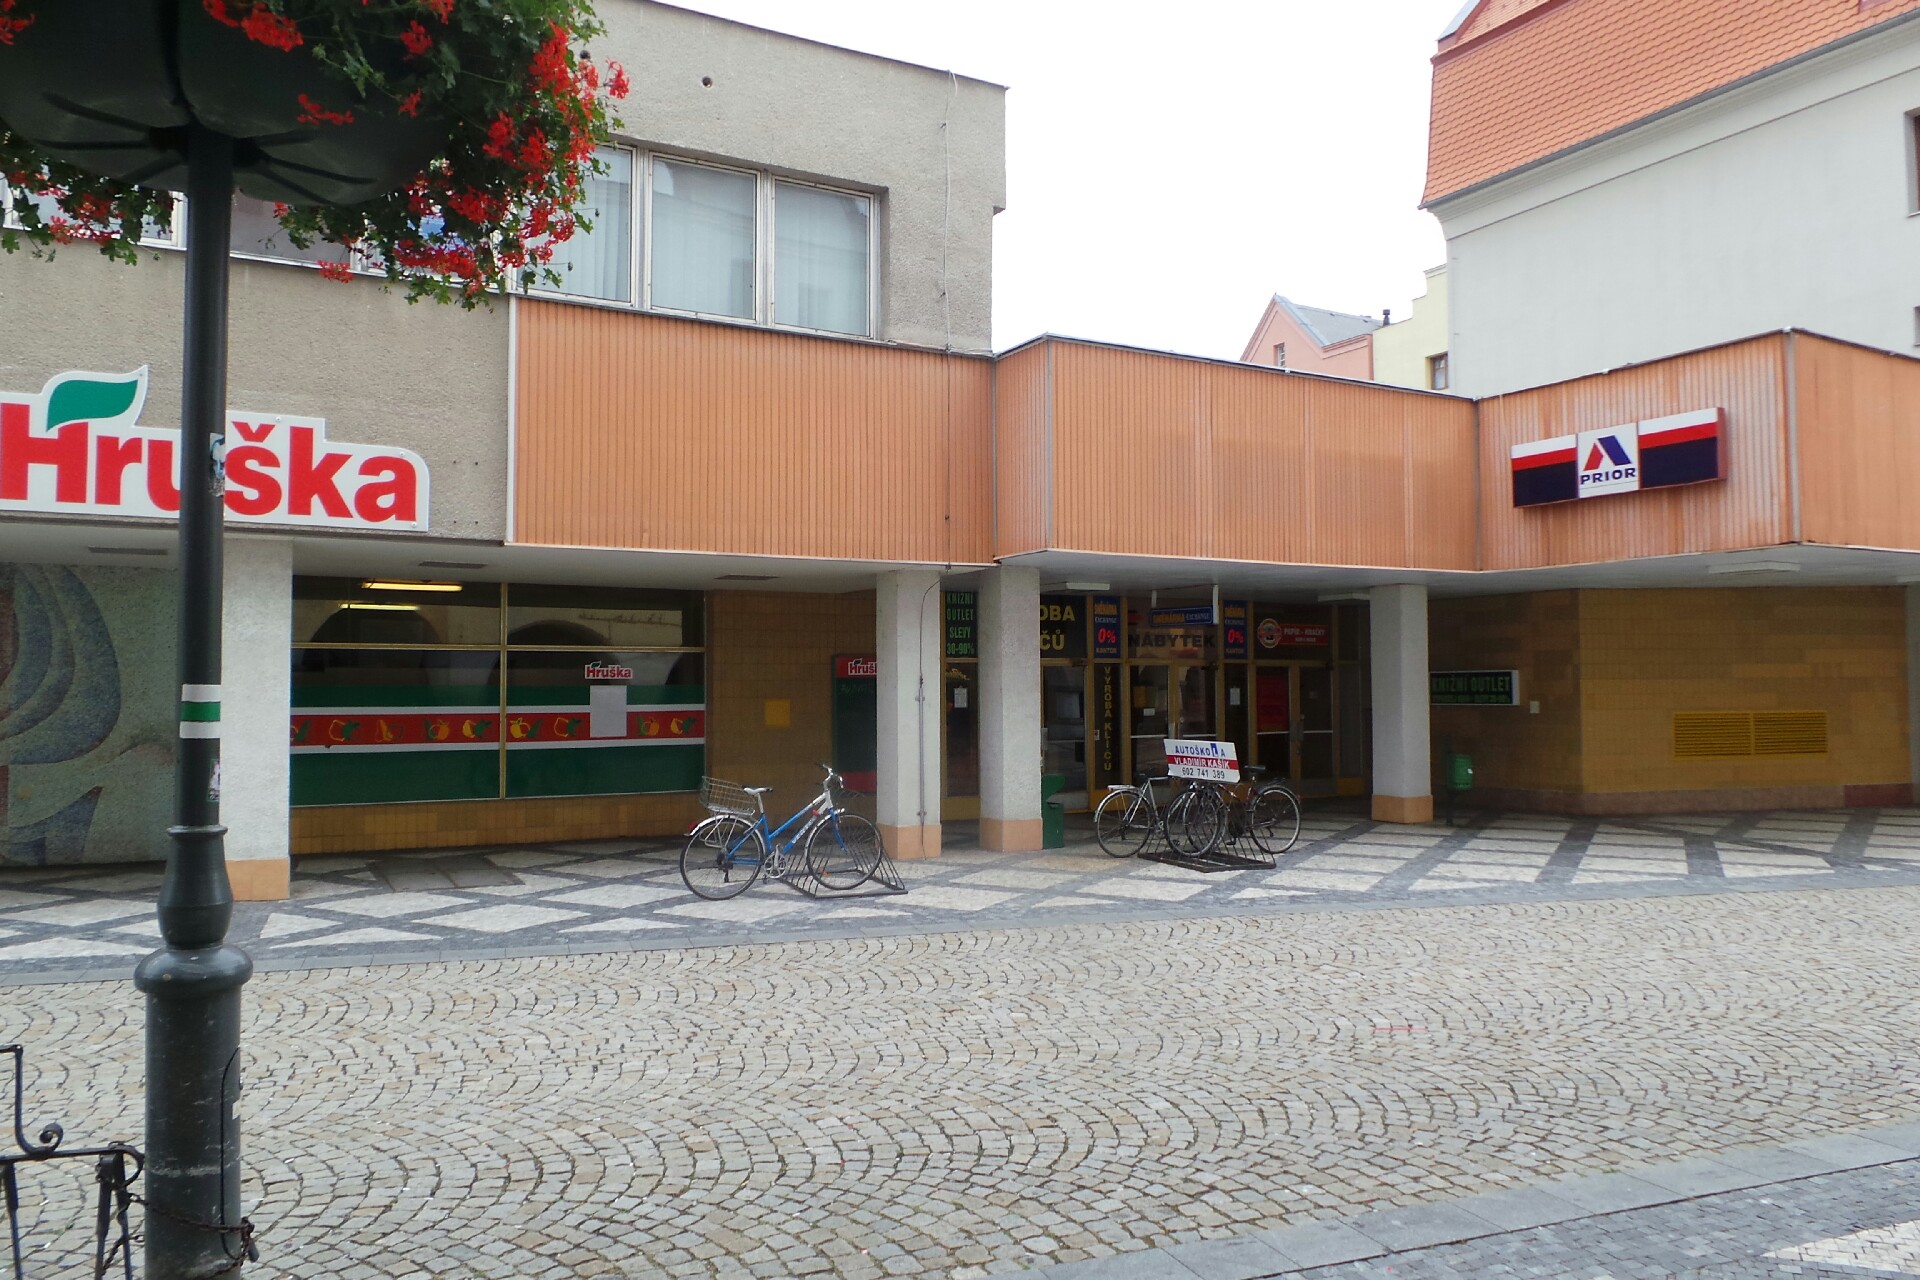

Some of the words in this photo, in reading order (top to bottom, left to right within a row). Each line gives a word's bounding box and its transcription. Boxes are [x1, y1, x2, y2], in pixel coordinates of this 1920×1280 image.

[0, 402, 417, 522] Hruška
[1581, 468, 1636, 485] PRIOR
[947, 609, 973, 621] OUTLET
[950, 627, 971, 639] SLEVY
[1097, 627, 1117, 643] 0%
[1128, 632, 1216, 648] NÁBYTEK
[1227, 627, 1245, 644] 0%
[947, 642, 975, 654] 30-90%
[586, 666, 632, 678] Hruška
[1471, 675, 1510, 692] OUTLET
[1174, 756, 1207, 767] VLADIMÍR
[1207, 759, 1230, 769] KAŠÍK
[1182, 767, 1194, 776] 602
[1197, 768, 1209, 777] 741
[1212, 769, 1225, 779] 389
